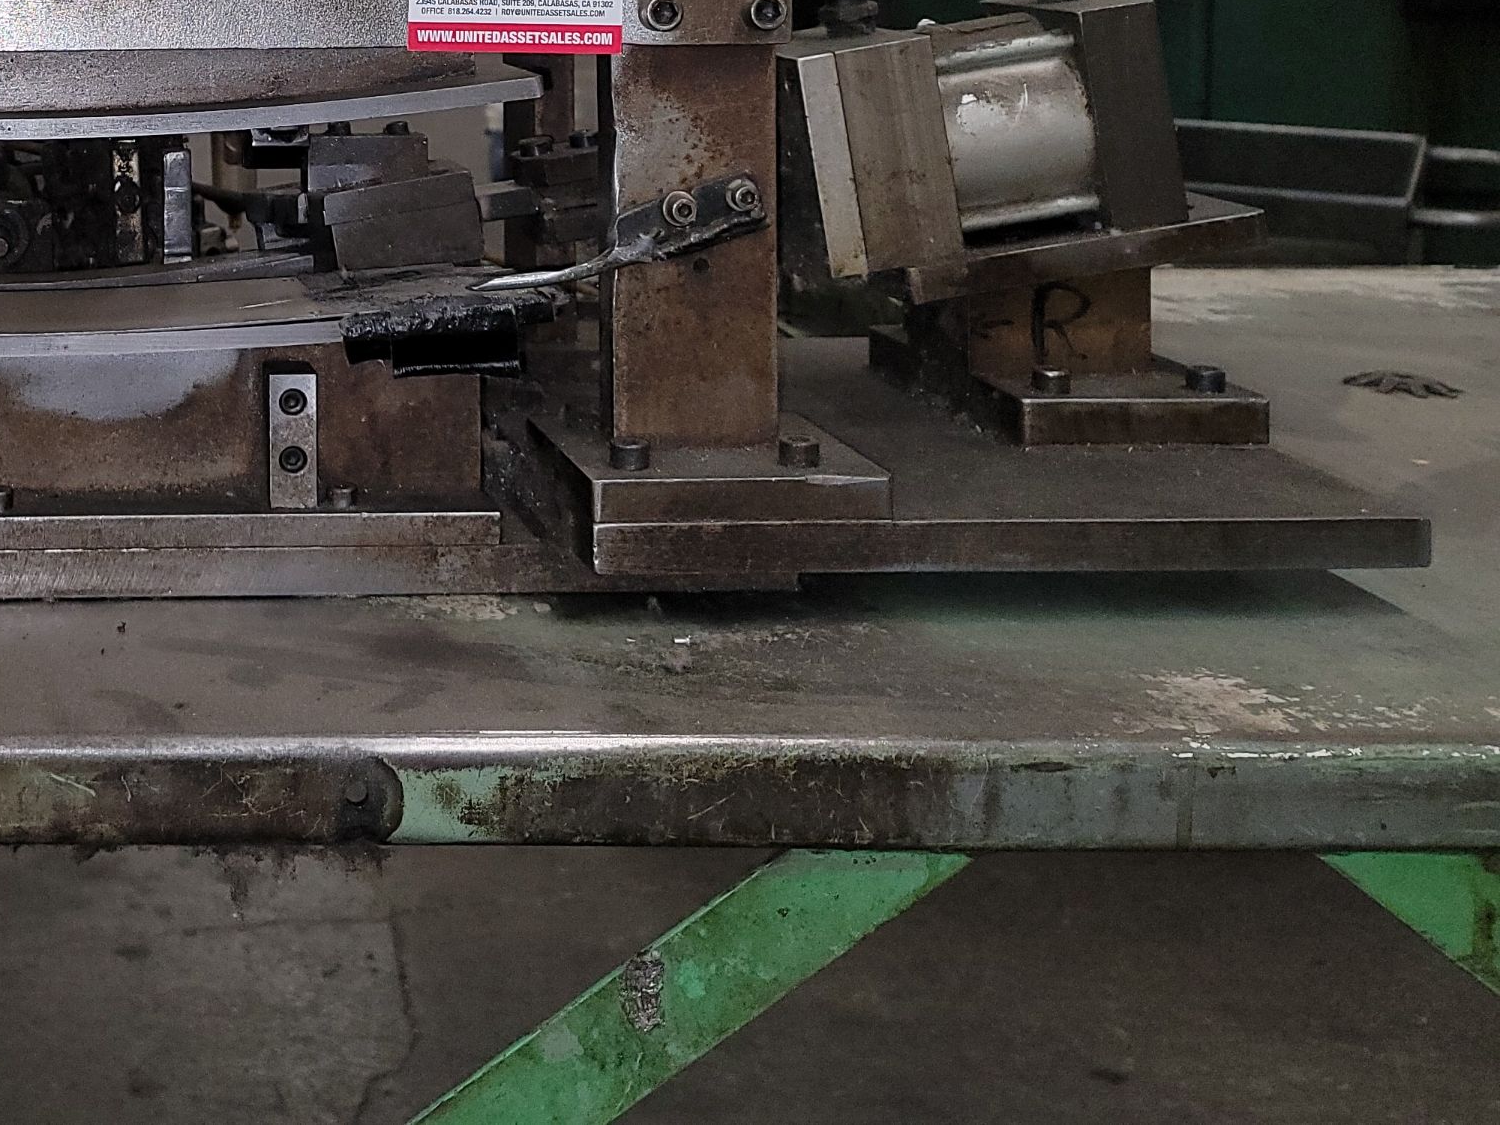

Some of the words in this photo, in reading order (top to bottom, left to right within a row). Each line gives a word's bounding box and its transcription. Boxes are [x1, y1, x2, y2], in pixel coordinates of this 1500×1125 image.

[522, 0, 536, 7] 209,
[537, 0, 581, 8] CALABASAS,
[421, 7, 444, 15] OFFICE
[501, 8, 606, 17] ROY@UNITEDASSETSALES.COM
[417, 29, 613, 46] WWW.UNITEDASSETSALES.COM
